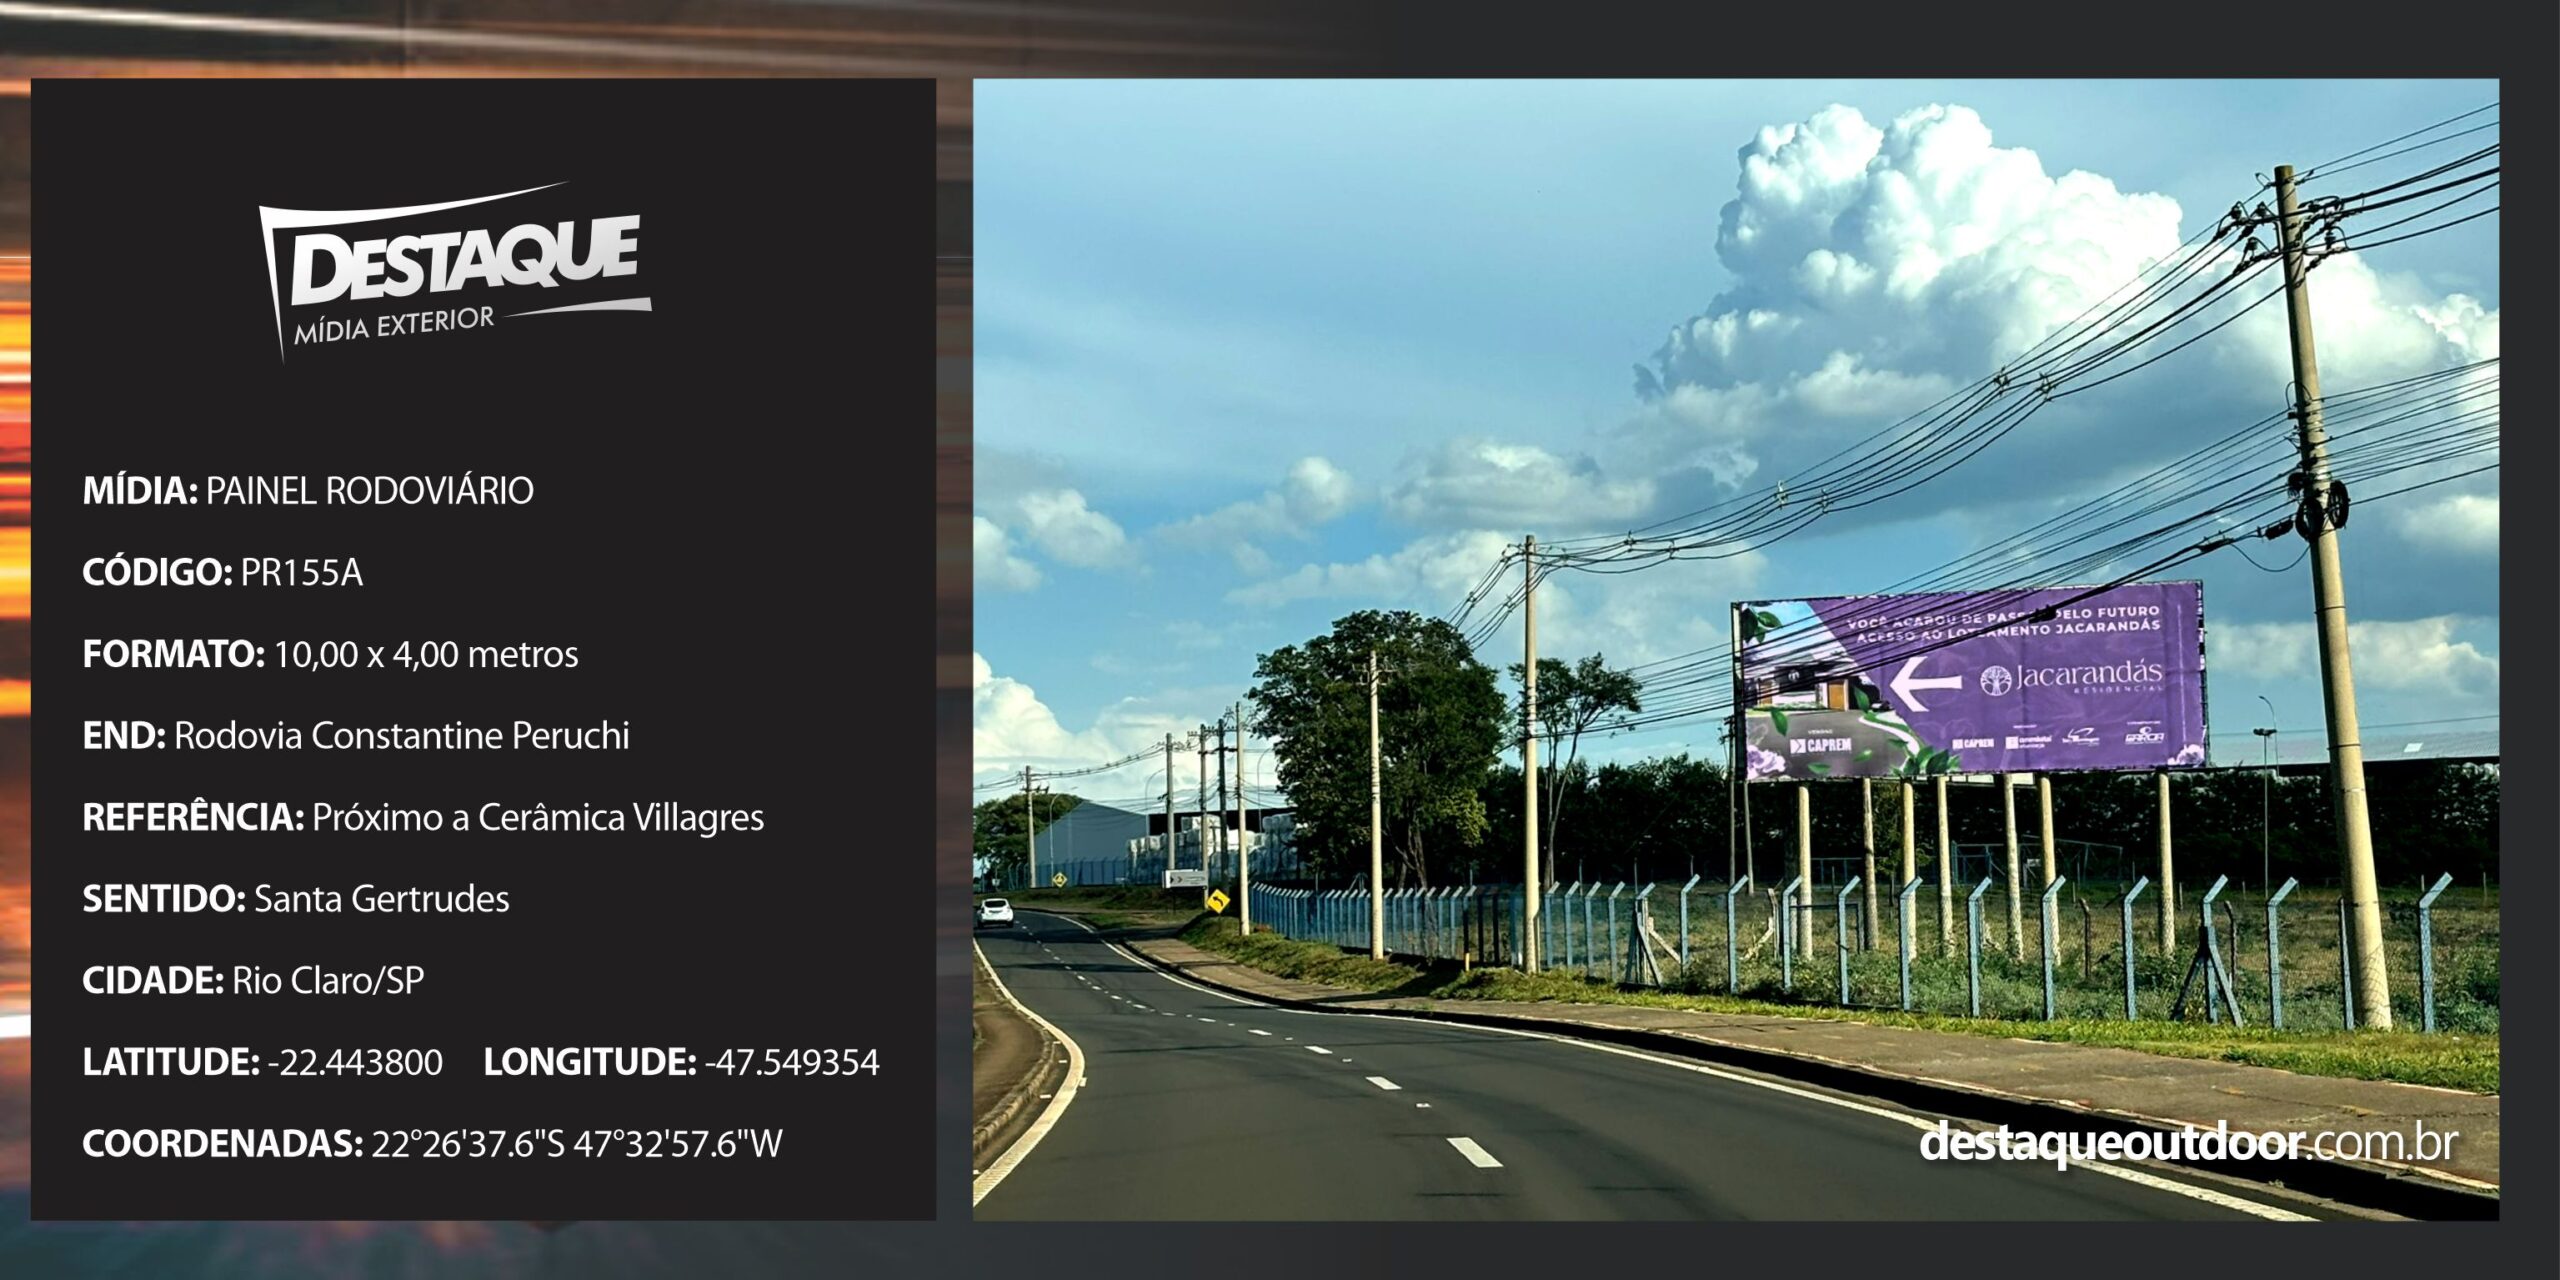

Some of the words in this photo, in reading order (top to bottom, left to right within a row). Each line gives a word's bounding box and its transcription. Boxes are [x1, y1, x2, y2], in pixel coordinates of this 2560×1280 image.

[1987, 609, 2048, 623] PASS
[2098, 606, 2160, 618] FUTURO
[2056, 618, 2161, 634] JACARANDÁS
[2017, 658, 2163, 690] Jacarandás
[1807, 738, 1852, 752] CAPREM
